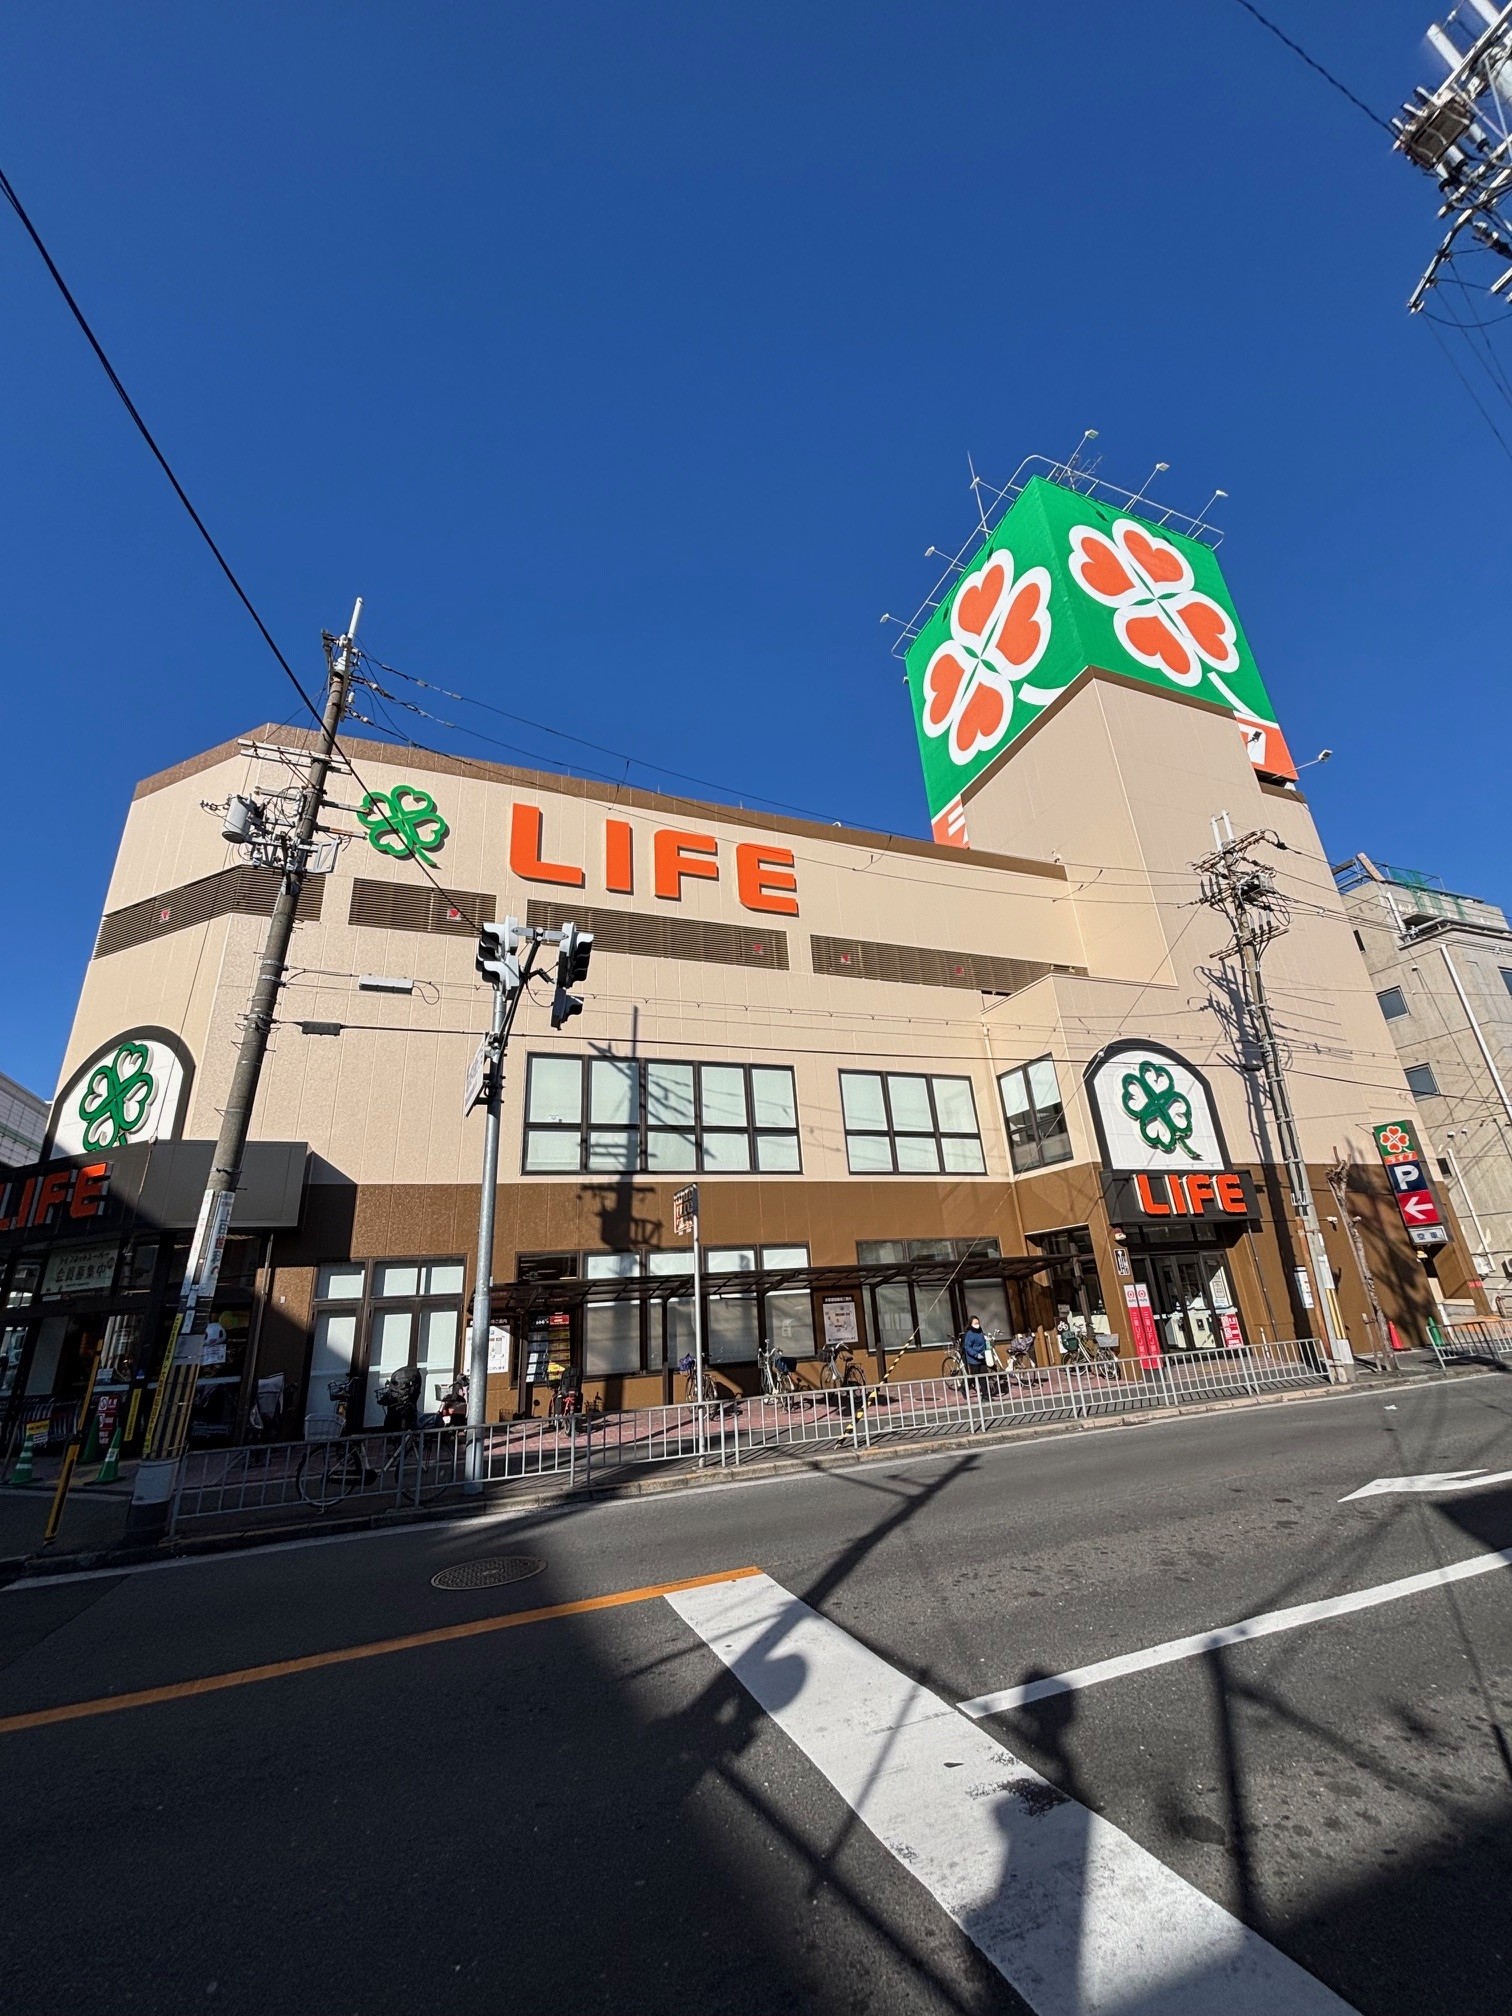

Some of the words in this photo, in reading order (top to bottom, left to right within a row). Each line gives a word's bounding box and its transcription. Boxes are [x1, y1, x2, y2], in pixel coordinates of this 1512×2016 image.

[510, 803, 798, 914] LIFE
[1135, 1173, 1247, 1214] LIFE
[1394, 1165, 1419, 1190] P
